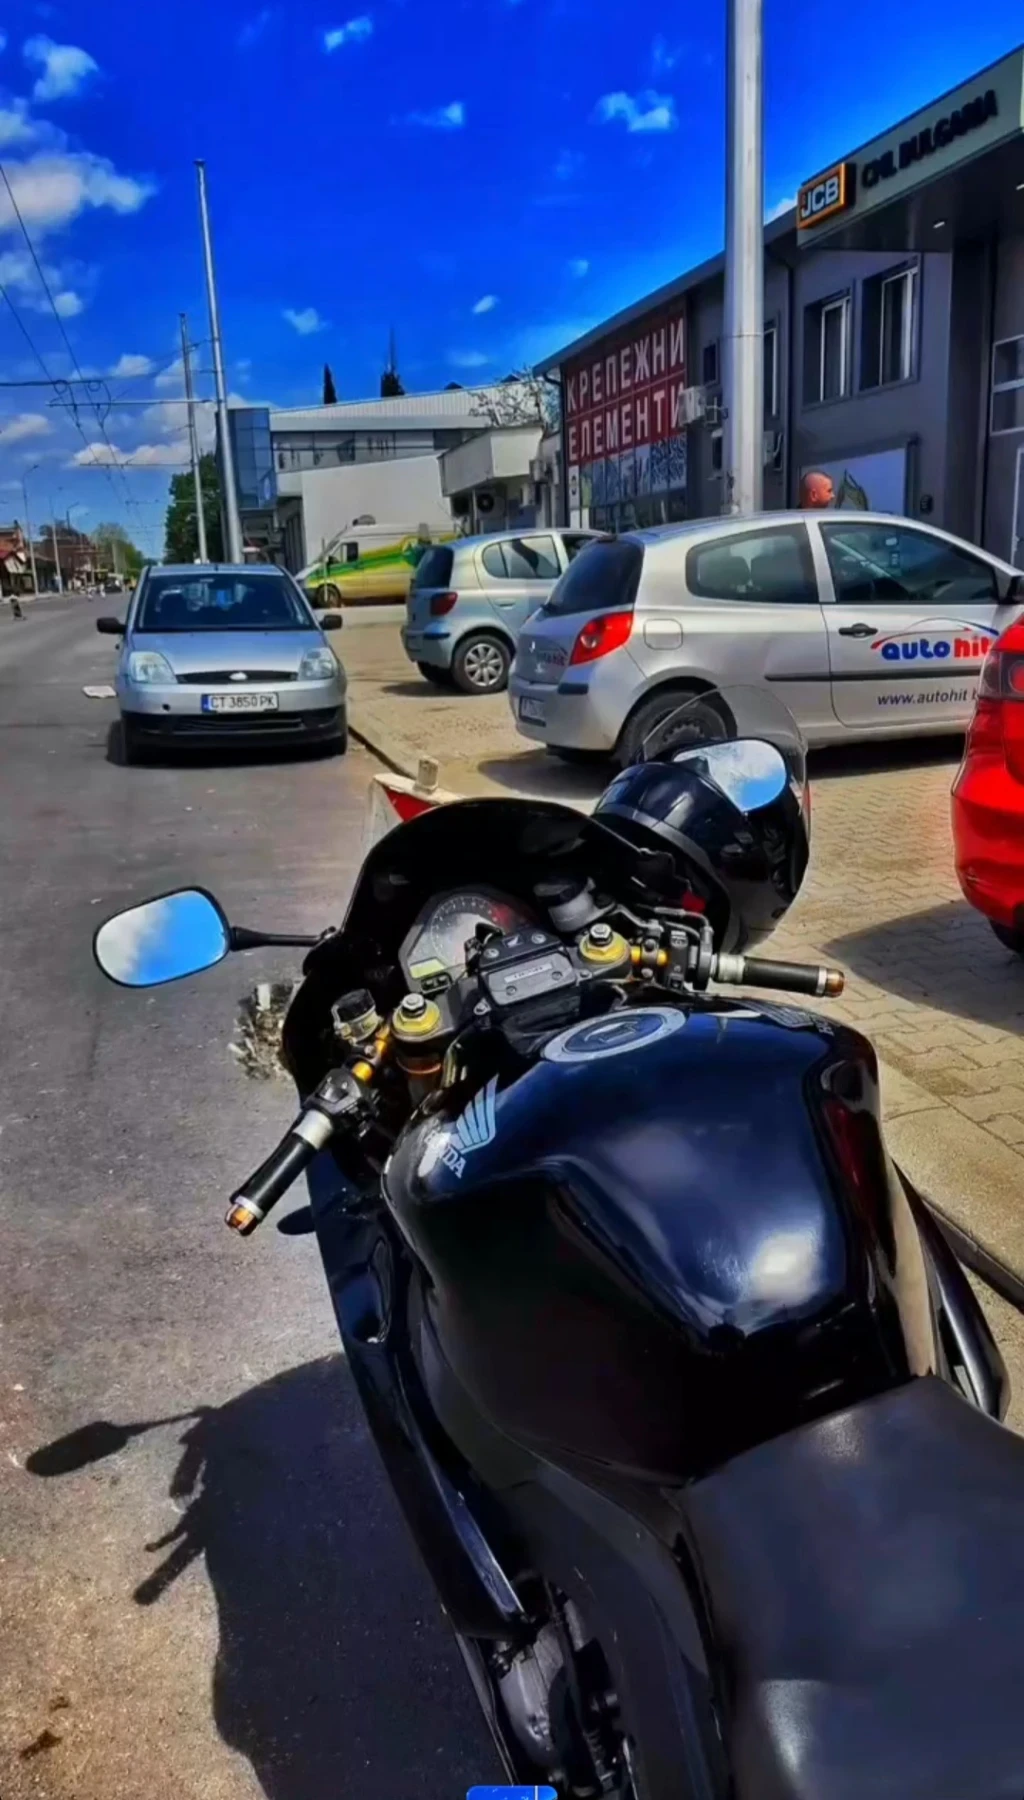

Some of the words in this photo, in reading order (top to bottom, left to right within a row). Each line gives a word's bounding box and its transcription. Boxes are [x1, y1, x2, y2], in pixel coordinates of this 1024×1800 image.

[801, 177, 840, 217] JCB
[567, 318, 684, 413] КРЕПЕЖНИ
[569, 382, 685, 461] ЕЛЕМЕНТИ
[423, 1129, 467, 1179] HDA
